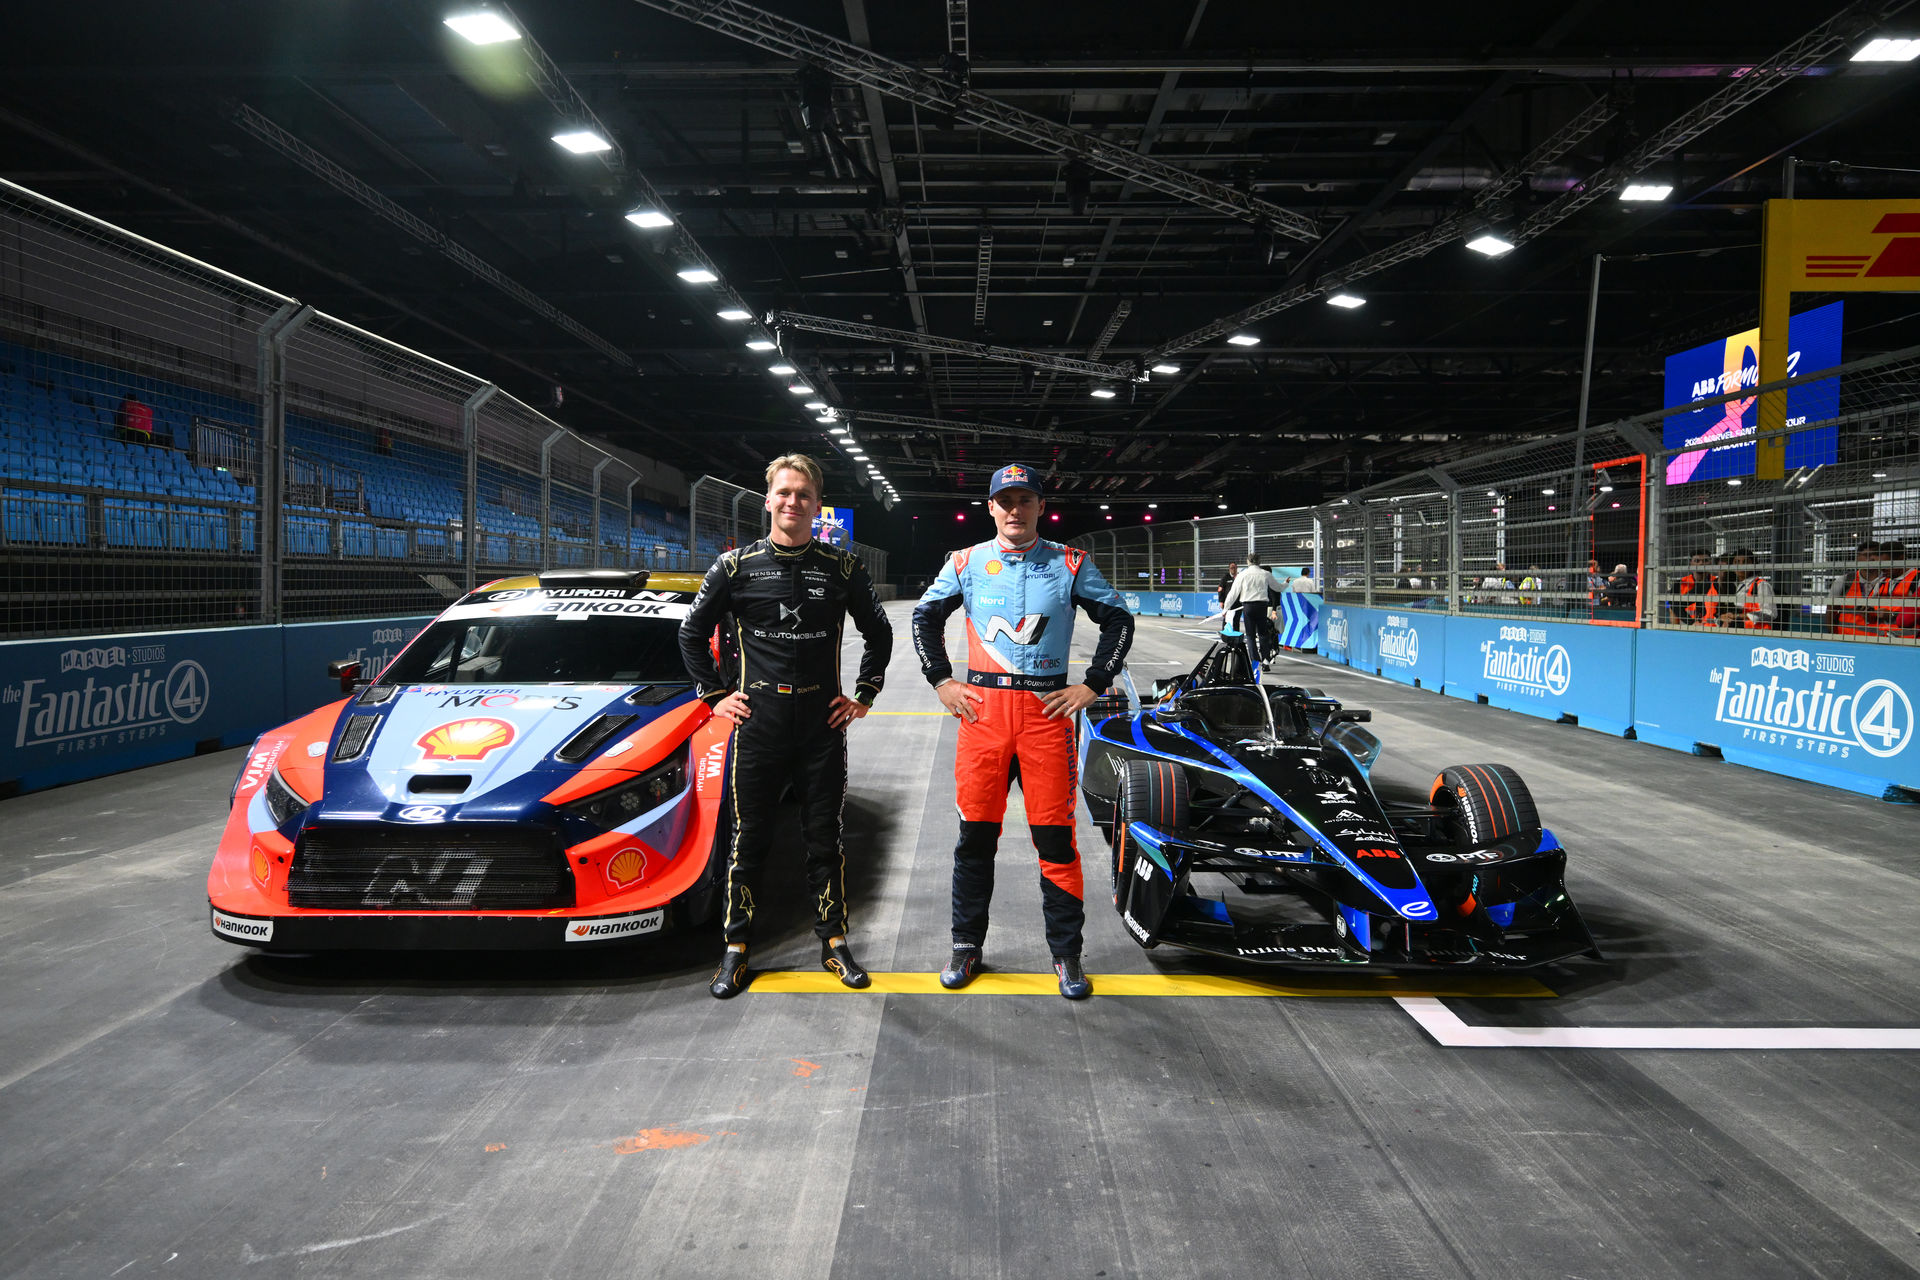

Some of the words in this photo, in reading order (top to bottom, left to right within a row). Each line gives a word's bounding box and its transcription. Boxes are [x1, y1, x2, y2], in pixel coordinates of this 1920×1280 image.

[1691, 378, 1715, 397] ABB
[1715, 365, 1759, 394] FORMU
[980, 596, 1005, 605] Nord
[754, 629, 766, 638] DS
[768, 631, 827, 640] AUTOMOBILES
[1112, 625, 1128, 660] HYUNDAI
[1380, 626, 1407, 658] Fantastic
[61, 646, 125, 673] MARVEL
[132, 648, 165, 663] STUDIOS
[1033, 658, 1060, 670] MOBIS
[1483, 640, 1545, 683] Fantastic
[1752, 647, 1809, 672] MARVEL
[1816, 655, 1854, 673] STUDIOS
[1709, 668, 1723, 684] the
[425, 689, 522, 697] HYUNDAI
[438, 694, 583, 710] MOS
[1496, 681, 1517, 692] FIRST
[1521, 686, 1545, 698] STEPS
[1715, 667, 1852, 736] Fantastic
[3, 685, 21, 703] the
[15, 669, 165, 748] Fantastic
[56, 738, 109, 754] FIRST
[118, 725, 166, 743] STEPS
[1743, 728, 1787, 746] FIRST
[1795, 738, 1850, 759] STEPS
[264, 740, 285, 772] HYUNDAI
[696, 757, 707, 792] HYUNDAI
[1356, 849, 1401, 858] ABB
[1135, 855, 1153, 881] ABB
[1236, 946, 1297, 955] Julius
